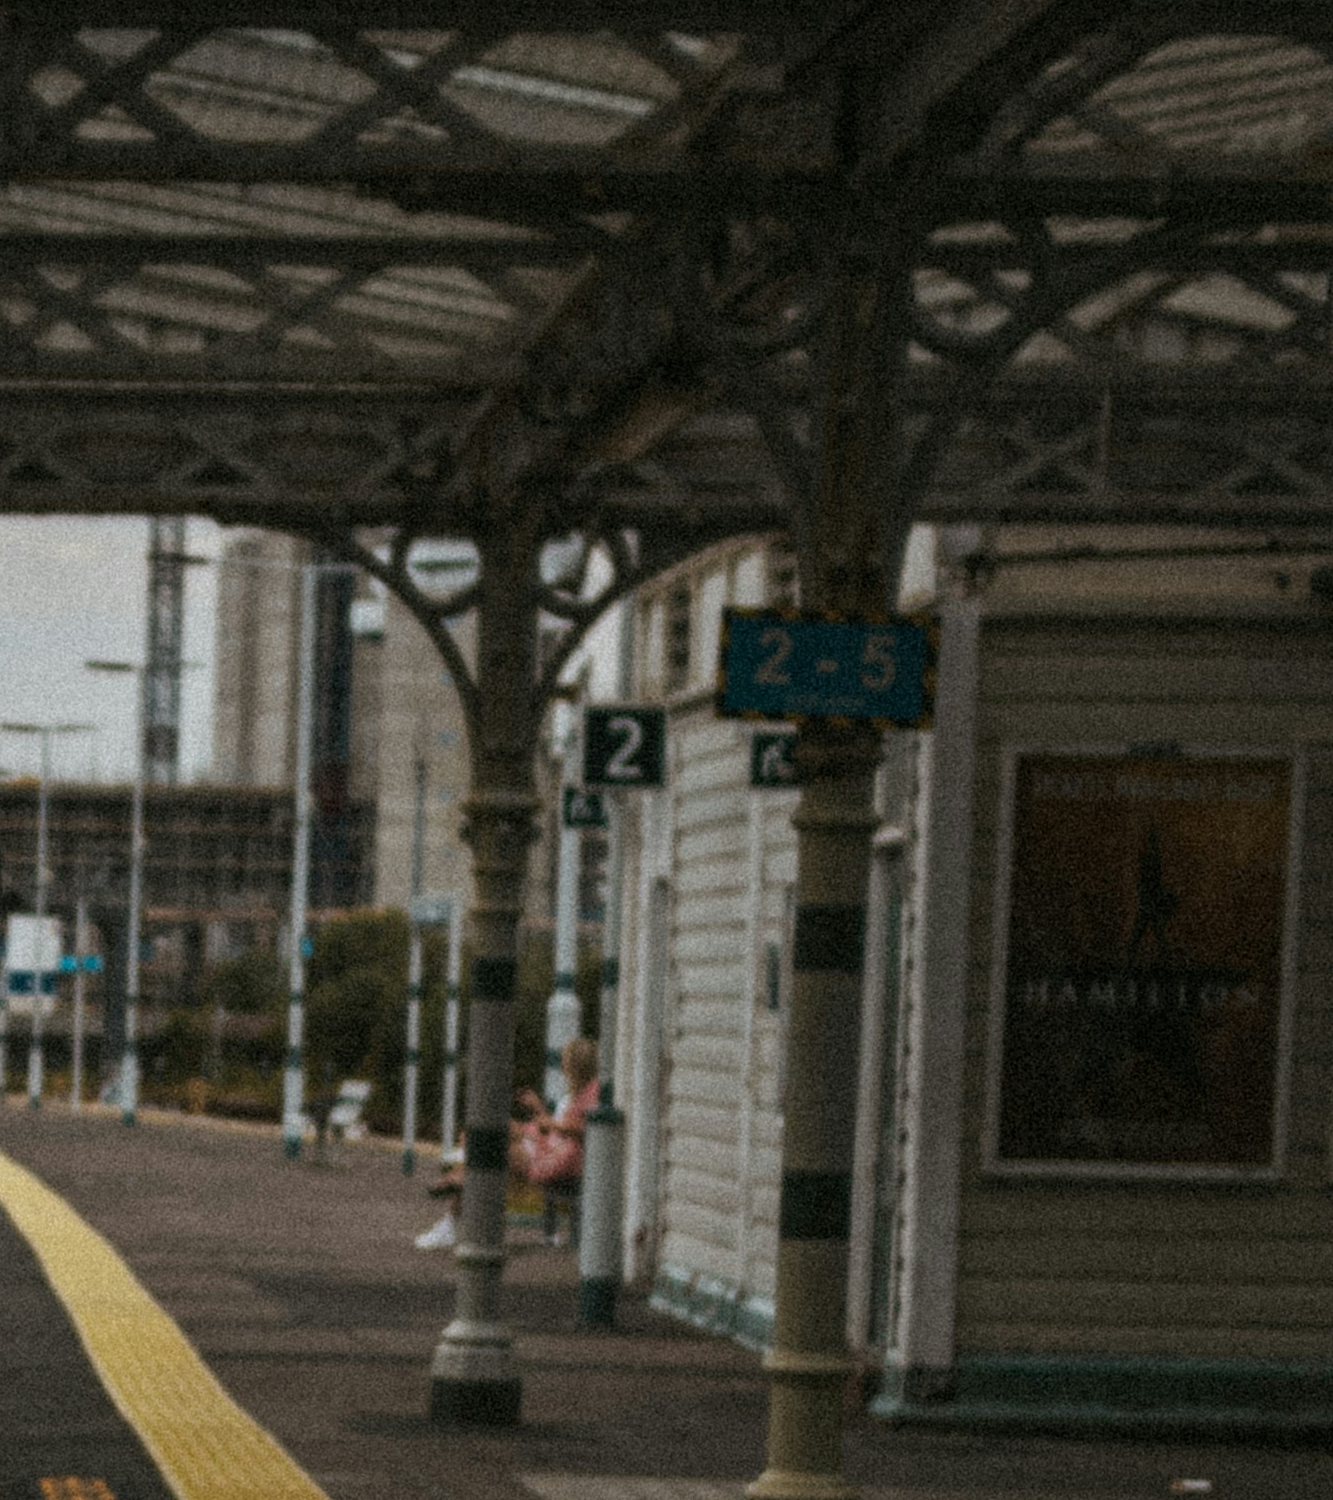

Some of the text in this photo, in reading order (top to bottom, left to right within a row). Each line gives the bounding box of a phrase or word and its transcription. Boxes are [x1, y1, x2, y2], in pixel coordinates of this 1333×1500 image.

[753, 628, 795, 687] 2
[859, 634, 898, 692] 5
[605, 716, 644, 779] 2
[1024, 980, 1260, 1008] HAMILTON
